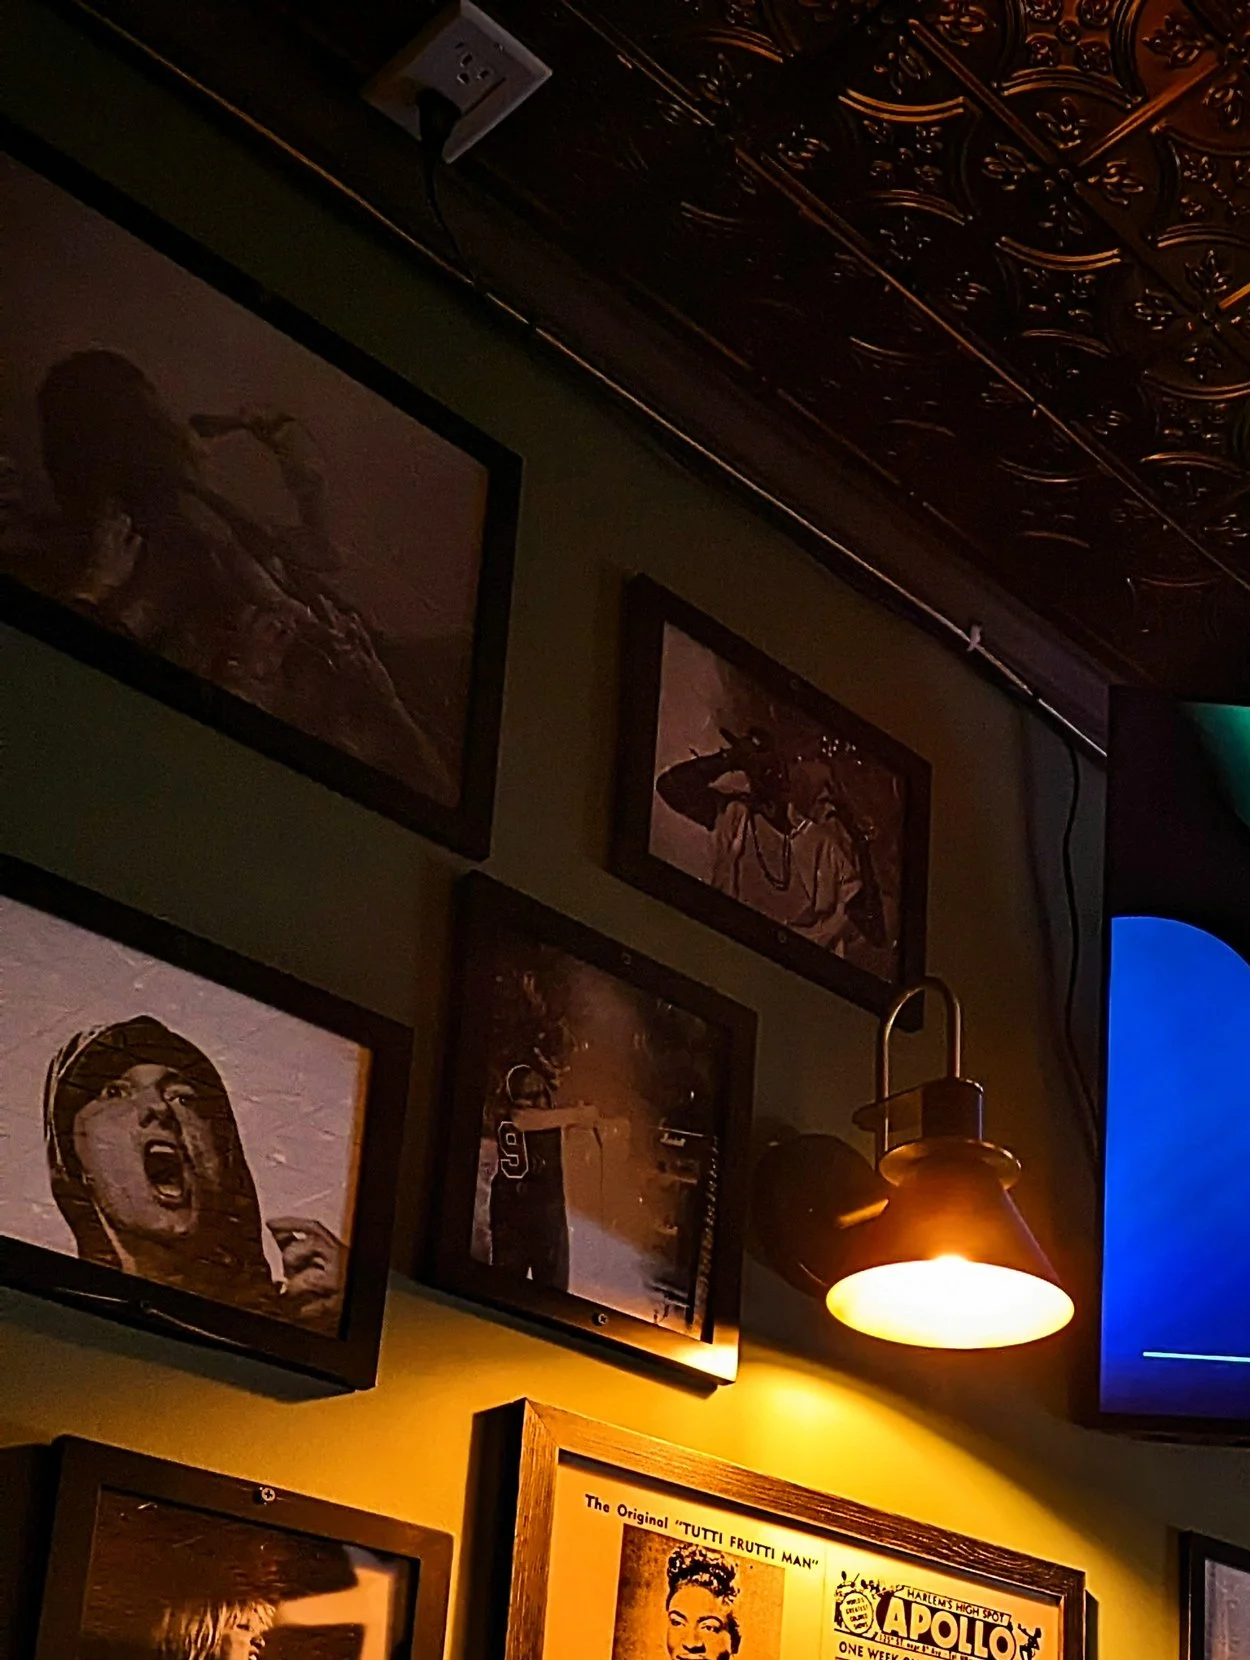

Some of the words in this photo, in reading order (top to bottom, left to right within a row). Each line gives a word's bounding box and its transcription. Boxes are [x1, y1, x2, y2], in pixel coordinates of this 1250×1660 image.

[585, 1493, 610, 1513] The
[617, 1504, 668, 1529] Original
[730, 1536, 775, 1560] FRUTTI
[907, 1589, 953, 1610] HARLEM'S
[955, 1603, 980, 1616] HIGH
[982, 1609, 1006, 1622] SPOT
[839, 1641, 863, 1658] ONE
